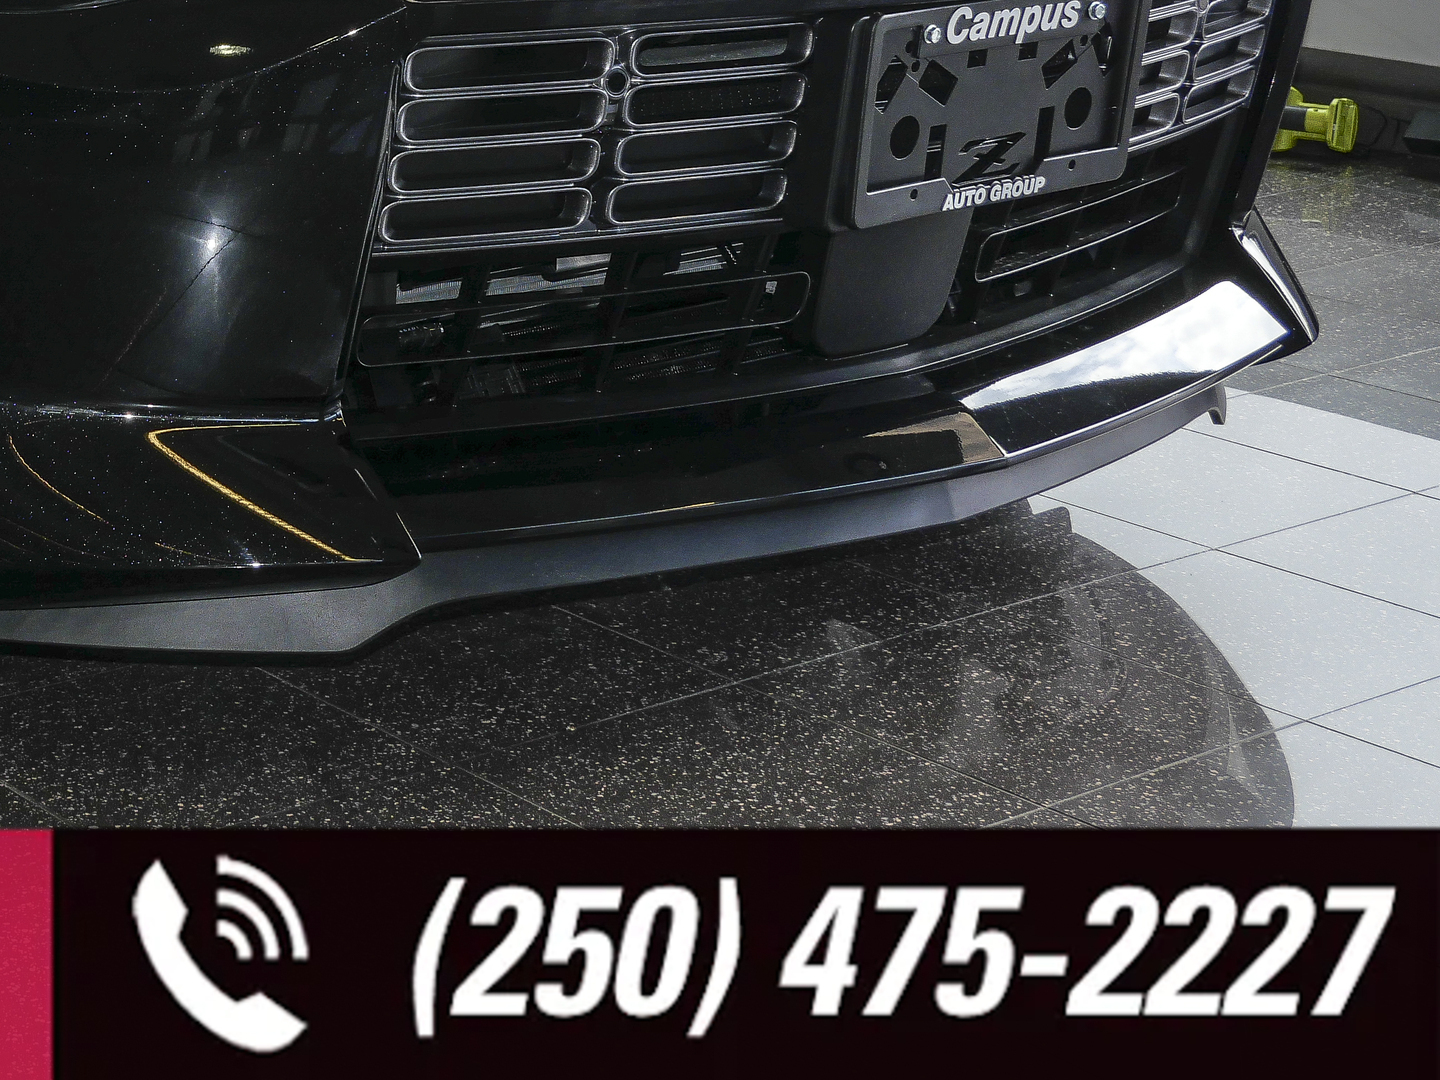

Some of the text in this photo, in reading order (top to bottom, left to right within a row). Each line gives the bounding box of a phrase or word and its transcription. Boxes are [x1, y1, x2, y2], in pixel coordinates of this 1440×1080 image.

[946, 0, 1082, 45] Campus
[942, 175, 1047, 211] AUTO GROUP
